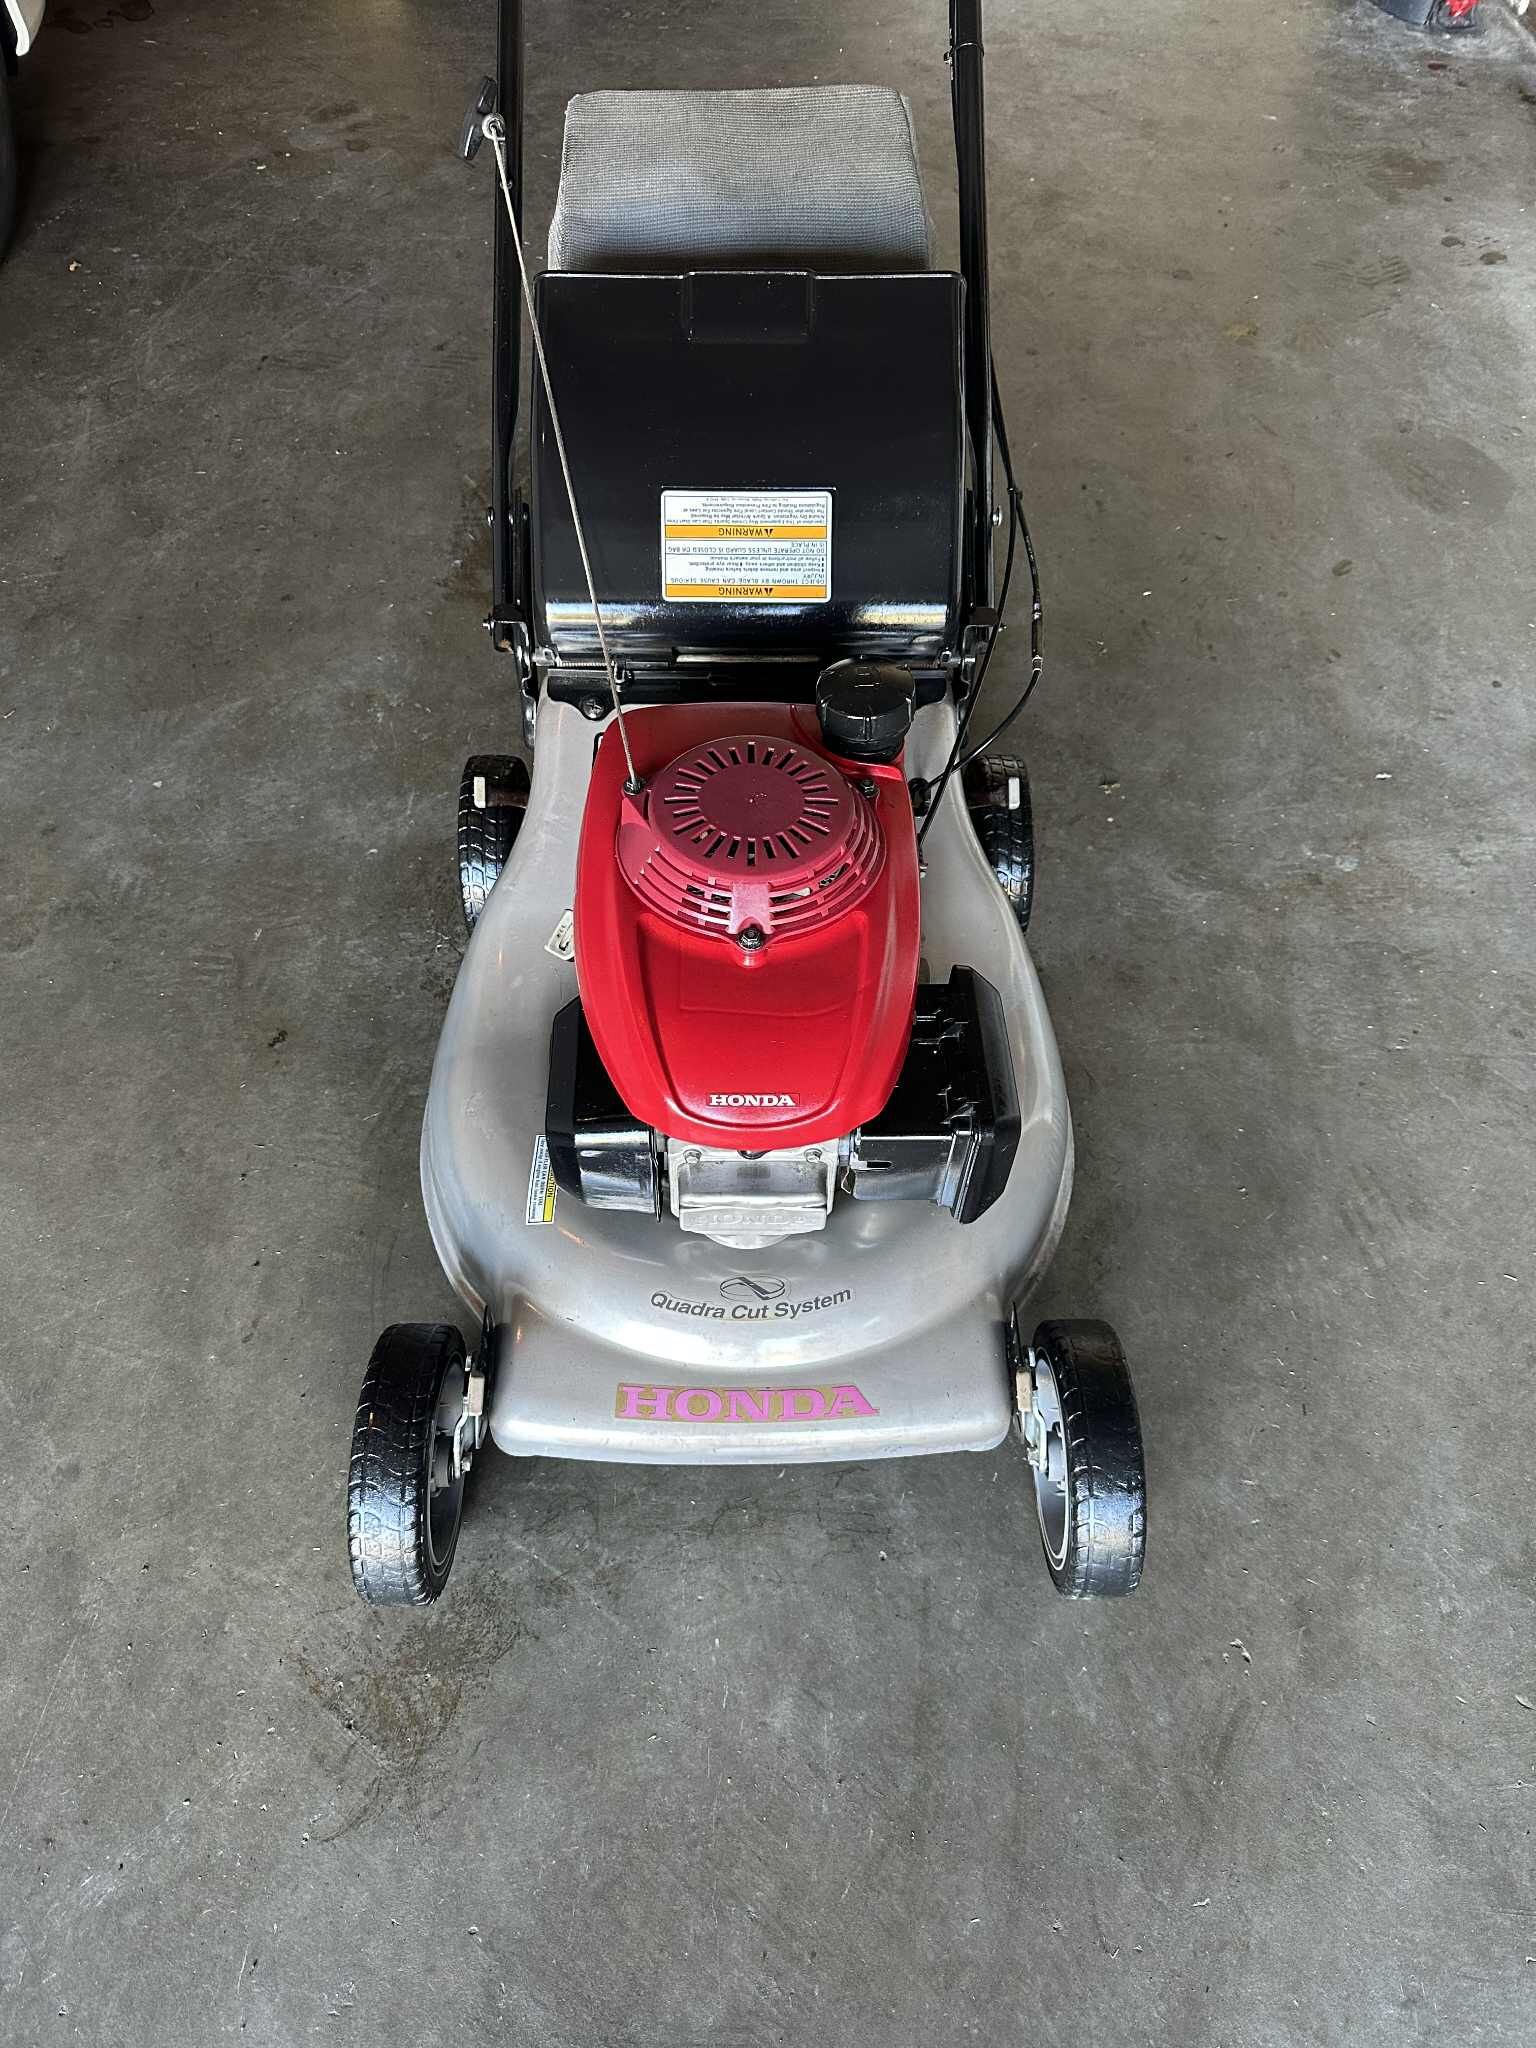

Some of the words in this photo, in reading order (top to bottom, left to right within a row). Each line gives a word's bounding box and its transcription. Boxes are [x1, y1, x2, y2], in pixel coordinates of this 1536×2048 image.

[718, 528, 763, 536] WARNING
[718, 587, 763, 595] WARNING
[709, 1094, 796, 1106] HONDA
[651, 1292, 725, 1319] Quadra
[731, 1305, 769, 1319] Cut
[775, 1289, 851, 1319] System
[621, 1384, 880, 1421] HONDA
